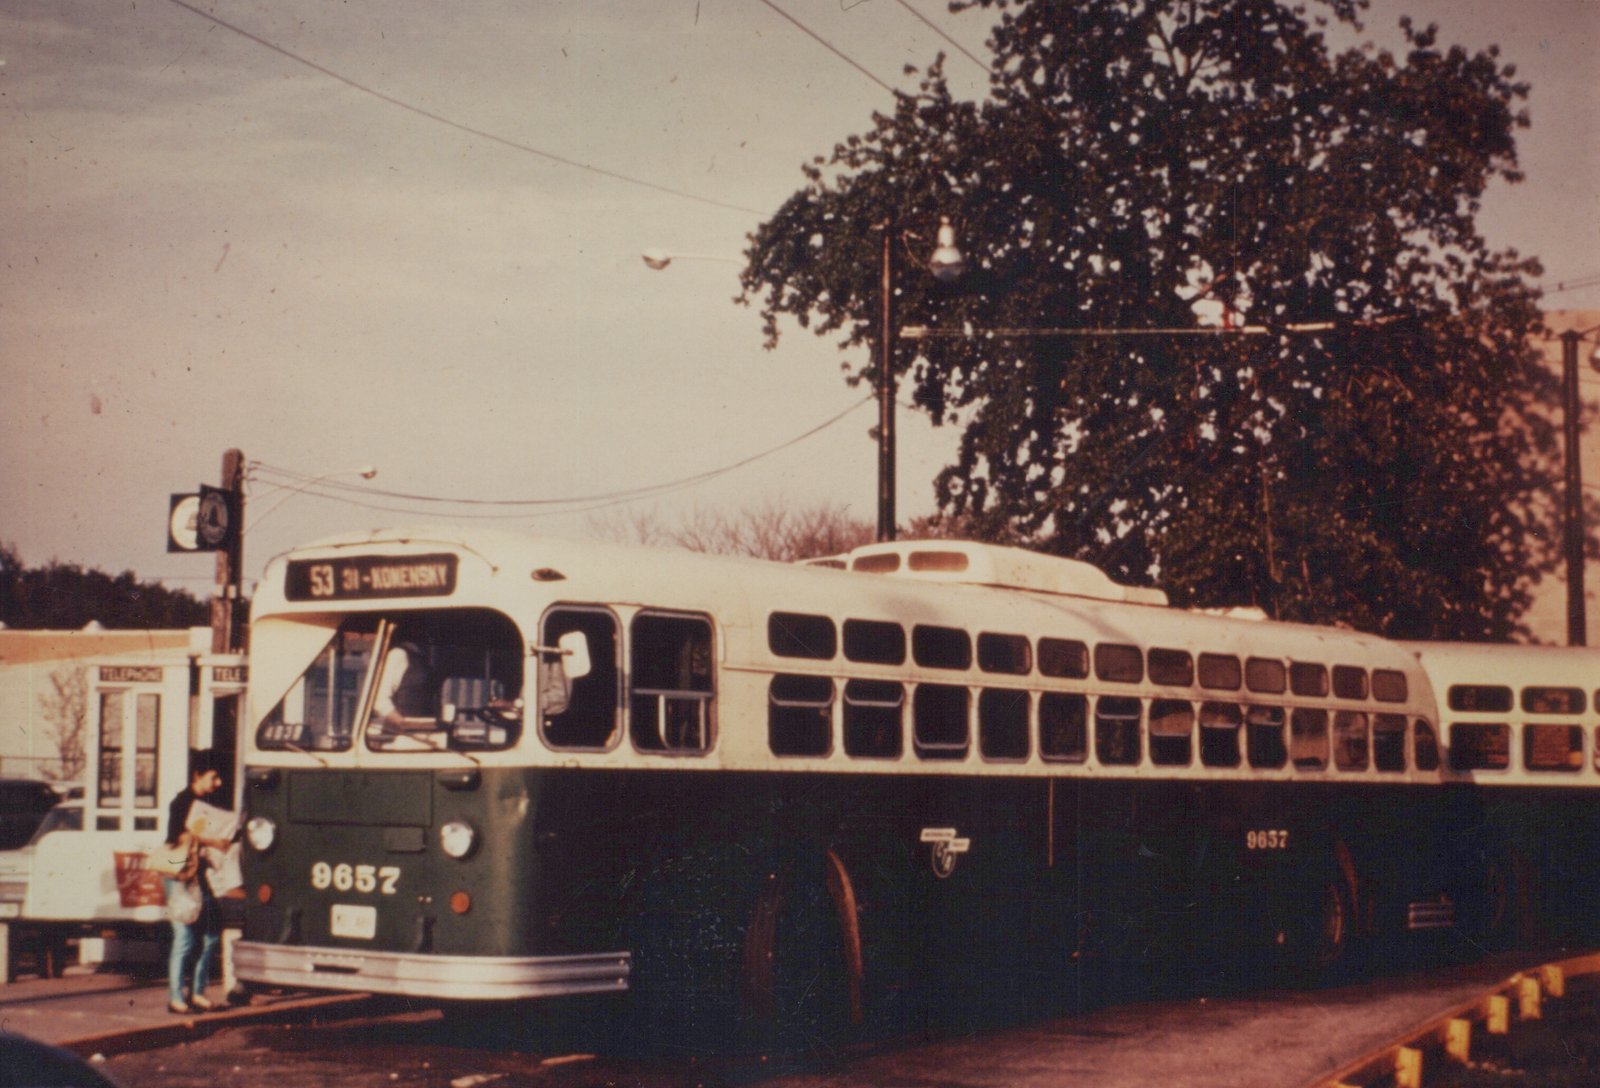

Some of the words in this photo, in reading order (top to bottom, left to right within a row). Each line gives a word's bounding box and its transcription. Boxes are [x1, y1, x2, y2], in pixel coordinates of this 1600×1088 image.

[310, 564, 335, 596] 53
[215, 667, 246, 681] TELE
[1247, 830, 1288, 849] 9657
[311, 861, 401, 894] 9657
